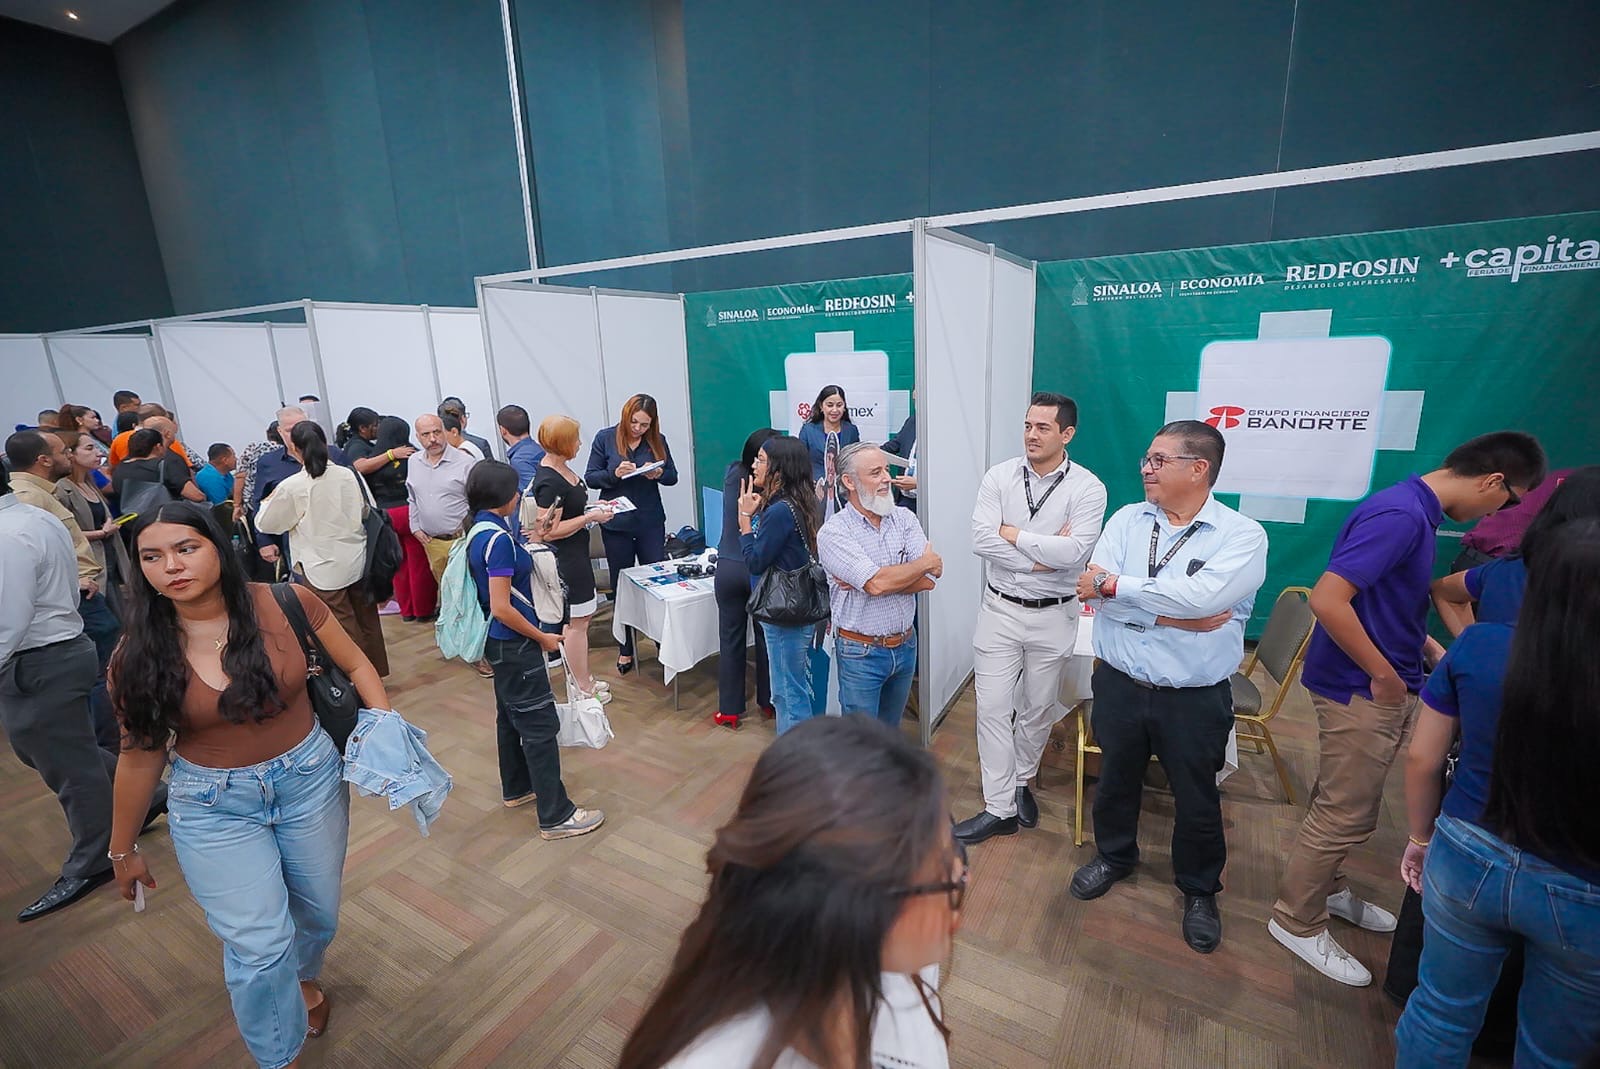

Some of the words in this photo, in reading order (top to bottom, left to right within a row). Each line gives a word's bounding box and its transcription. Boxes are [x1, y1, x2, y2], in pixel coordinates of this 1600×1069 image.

[1285, 256, 1420, 283] REDFOSIN
[1523, 261, 1600, 272] FINANCIAMIENT
[1179, 273, 1264, 290] ECONOMÍA
[1284, 281, 1344, 291] DESARROLLO
[1346, 277, 1417, 287] EMPRESARIAL
[1093, 282, 1163, 297] SINALOA
[767, 304, 815, 316] ECONOMÍA
[825, 294, 896, 312] REDFOSIN
[718, 309, 759, 321] SINALOA
[1248, 409, 1290, 417] GRUPO
[1293, 409, 1370, 418] FINANCIERO
[1247, 417, 1368, 431] BANORTE
